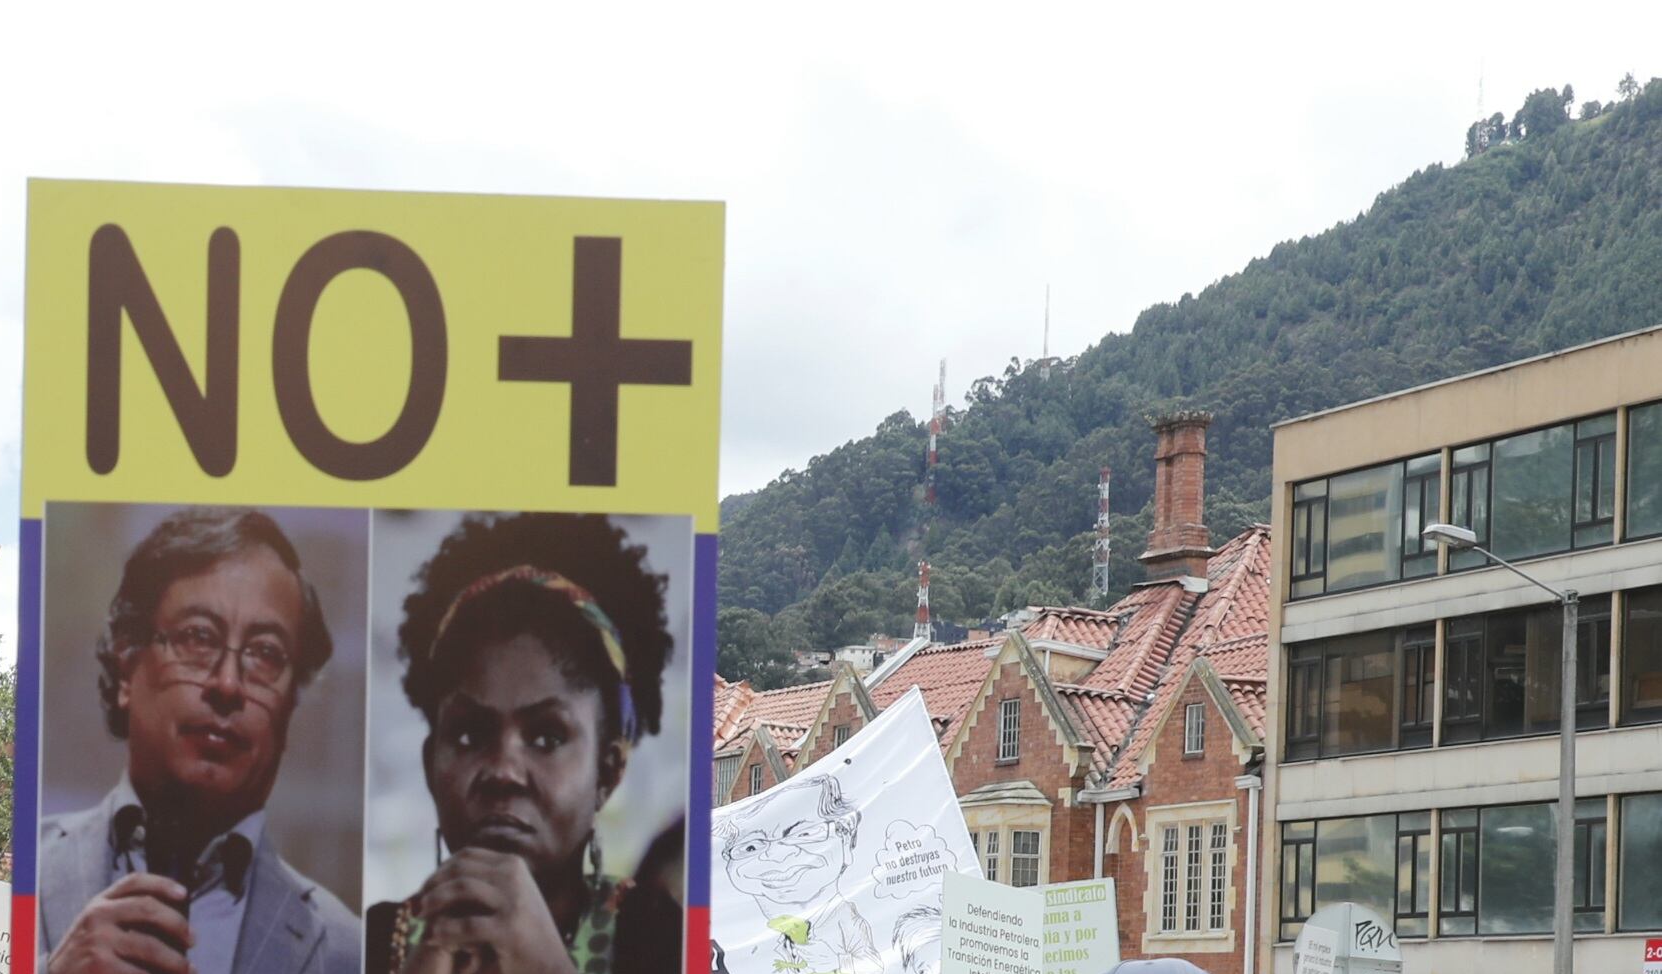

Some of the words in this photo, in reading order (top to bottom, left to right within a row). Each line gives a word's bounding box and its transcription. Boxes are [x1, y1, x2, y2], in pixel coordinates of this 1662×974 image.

[86, 223, 449, 482] NO
[498, 236, 693, 487] +
[895, 838, 922, 852] Petro
[885, 860, 898, 871] no
[900, 849, 940, 867] destruyas
[886, 871, 918, 886] nuestro
[967, 903, 1023, 926] Defendiendo
[949, 916, 957, 928] la
[959, 920, 998, 938] Industria
[1076, 927, 1097, 943] por
[948, 947, 992, 968] Transición
[960, 937, 1019, 959] promovemos
[1021, 949, 1029, 961] la
